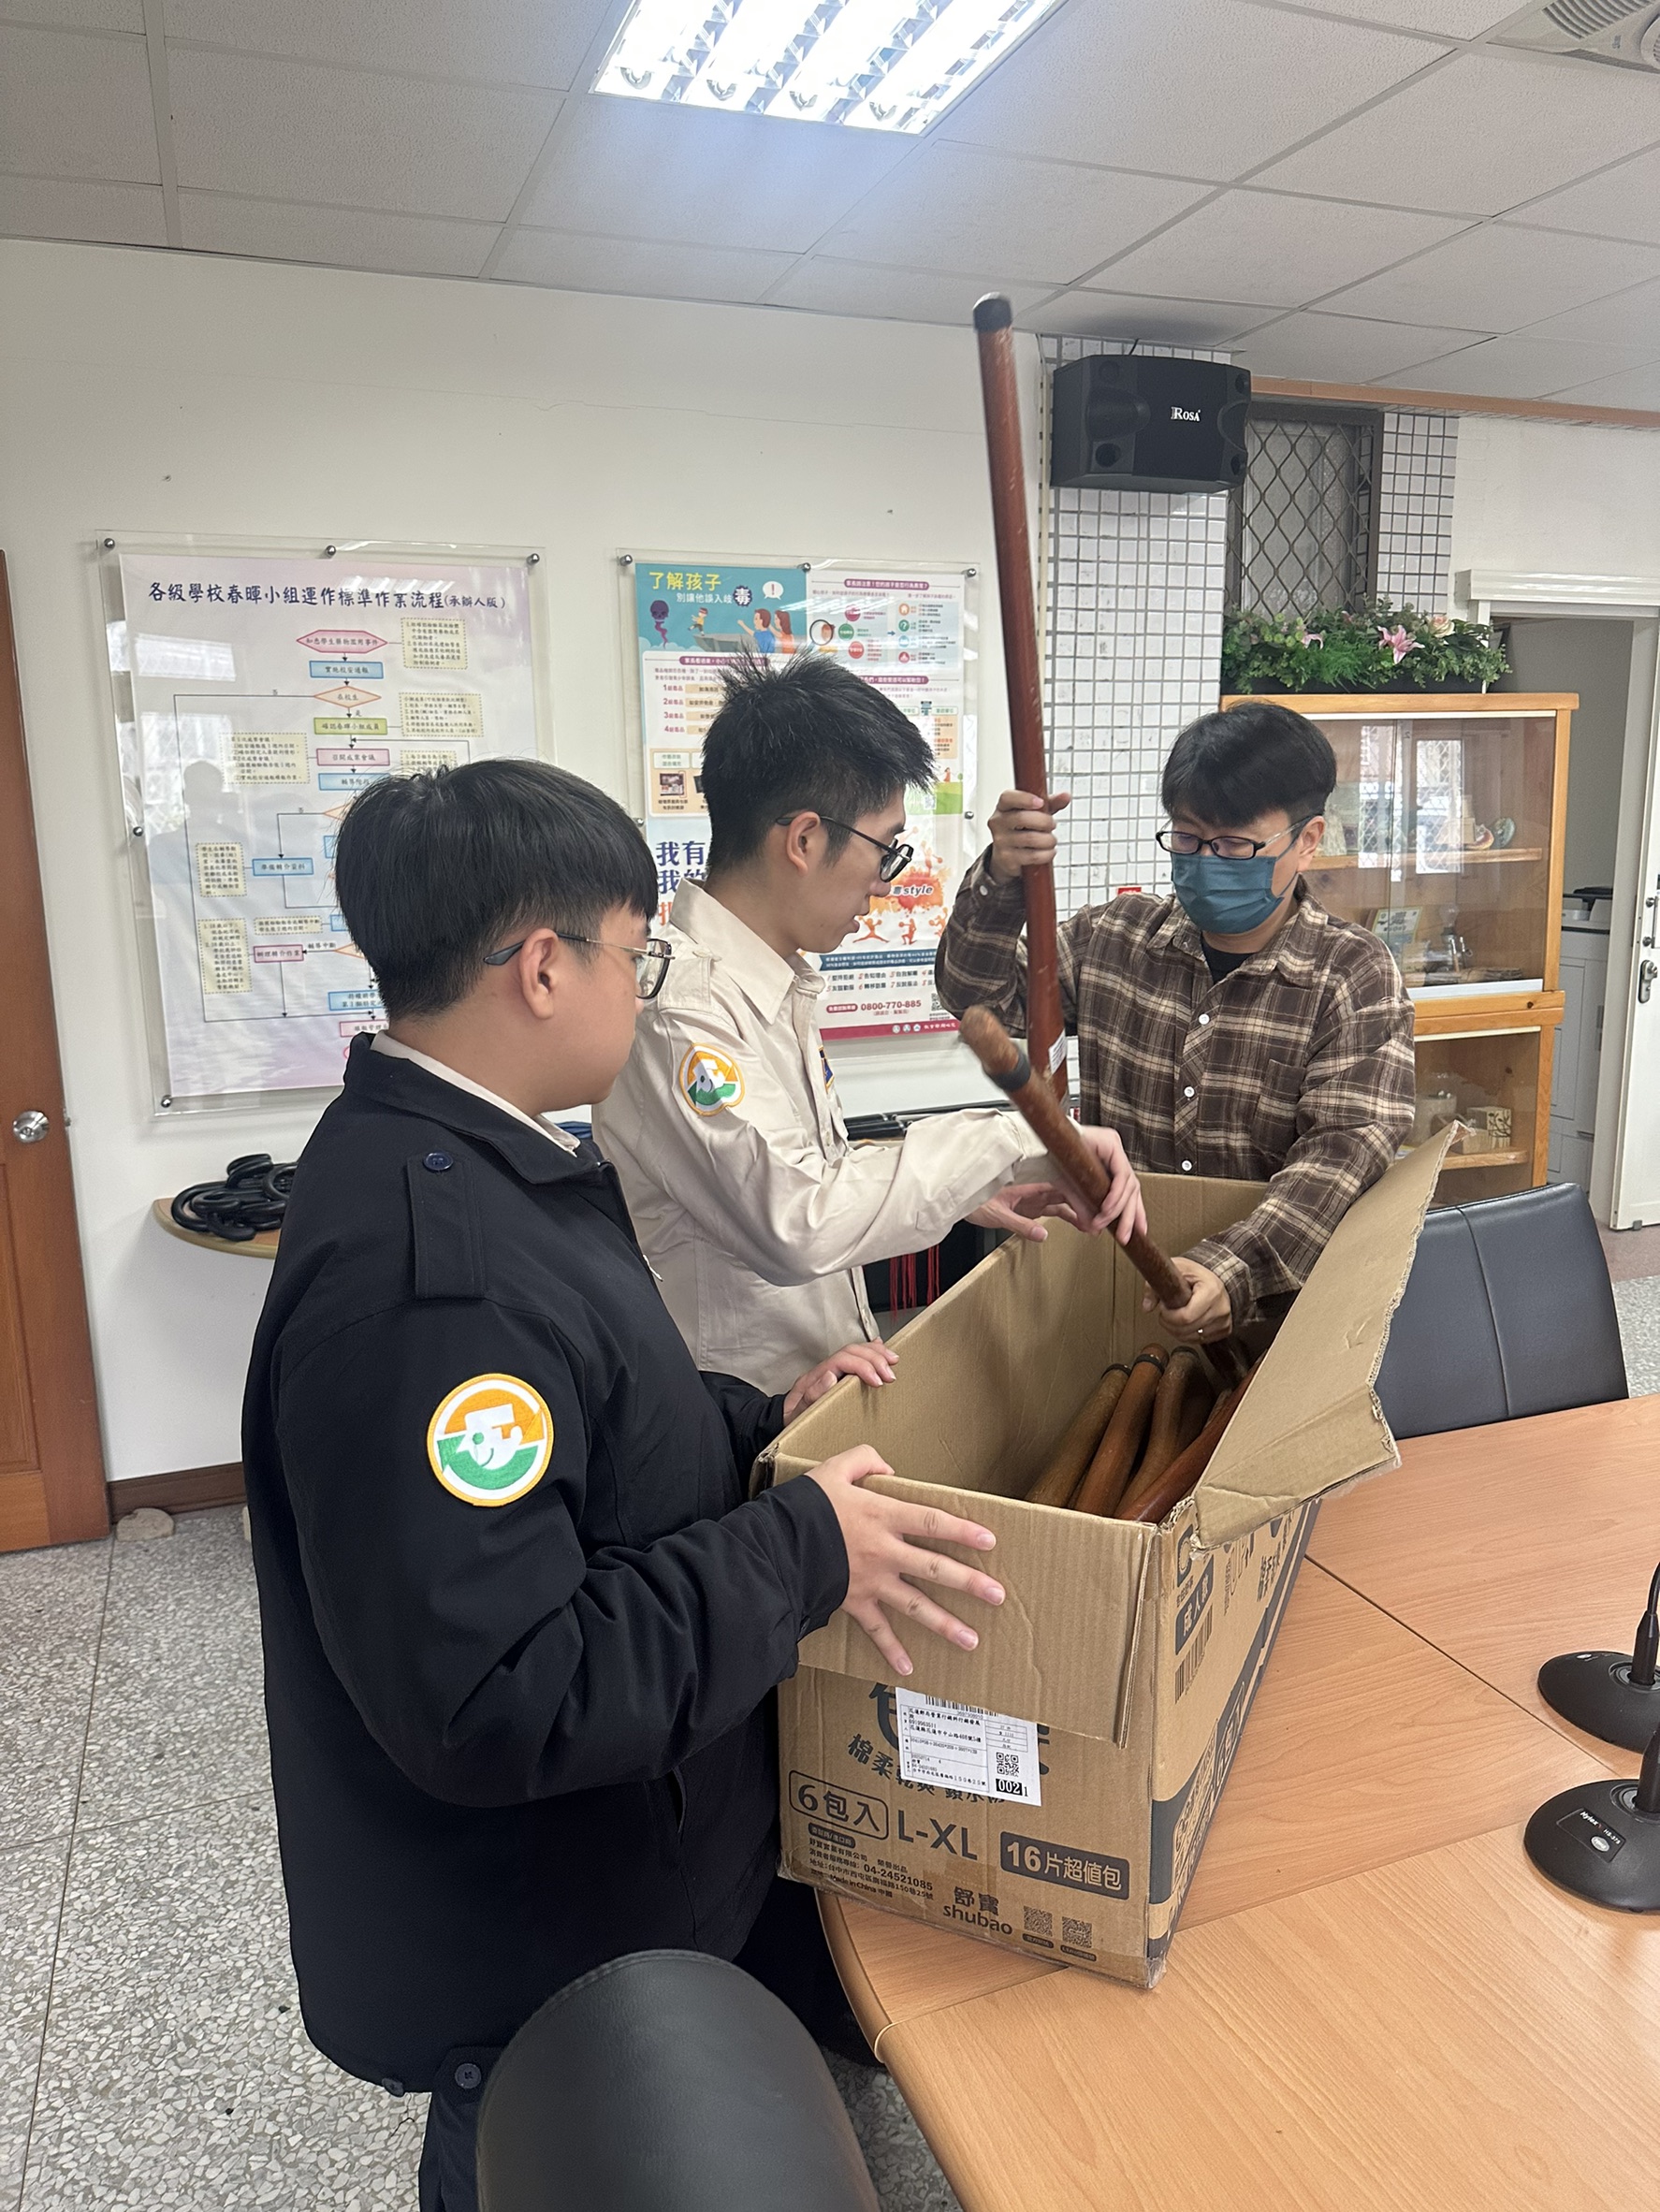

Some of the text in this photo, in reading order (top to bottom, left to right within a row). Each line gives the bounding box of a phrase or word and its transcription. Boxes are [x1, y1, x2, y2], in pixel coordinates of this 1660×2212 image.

[649, 572, 721, 591] 了解孩子
[656, 840, 706, 866] 我有
[861, 1000, 922, 1011] 0800-770-885
[998, 1780, 1019, 1794] 002
[798, 1783, 881, 1832] 6包入
[897, 1809, 979, 1861] L-XL
[864, 1863, 934, 1891] 04-24521085
[1007, 1841, 1122, 1891] 16片超值包
[856, 1881, 877, 1893] China
[954, 1885, 999, 1916] 舒寶
[943, 1903, 1013, 1936] shubao
